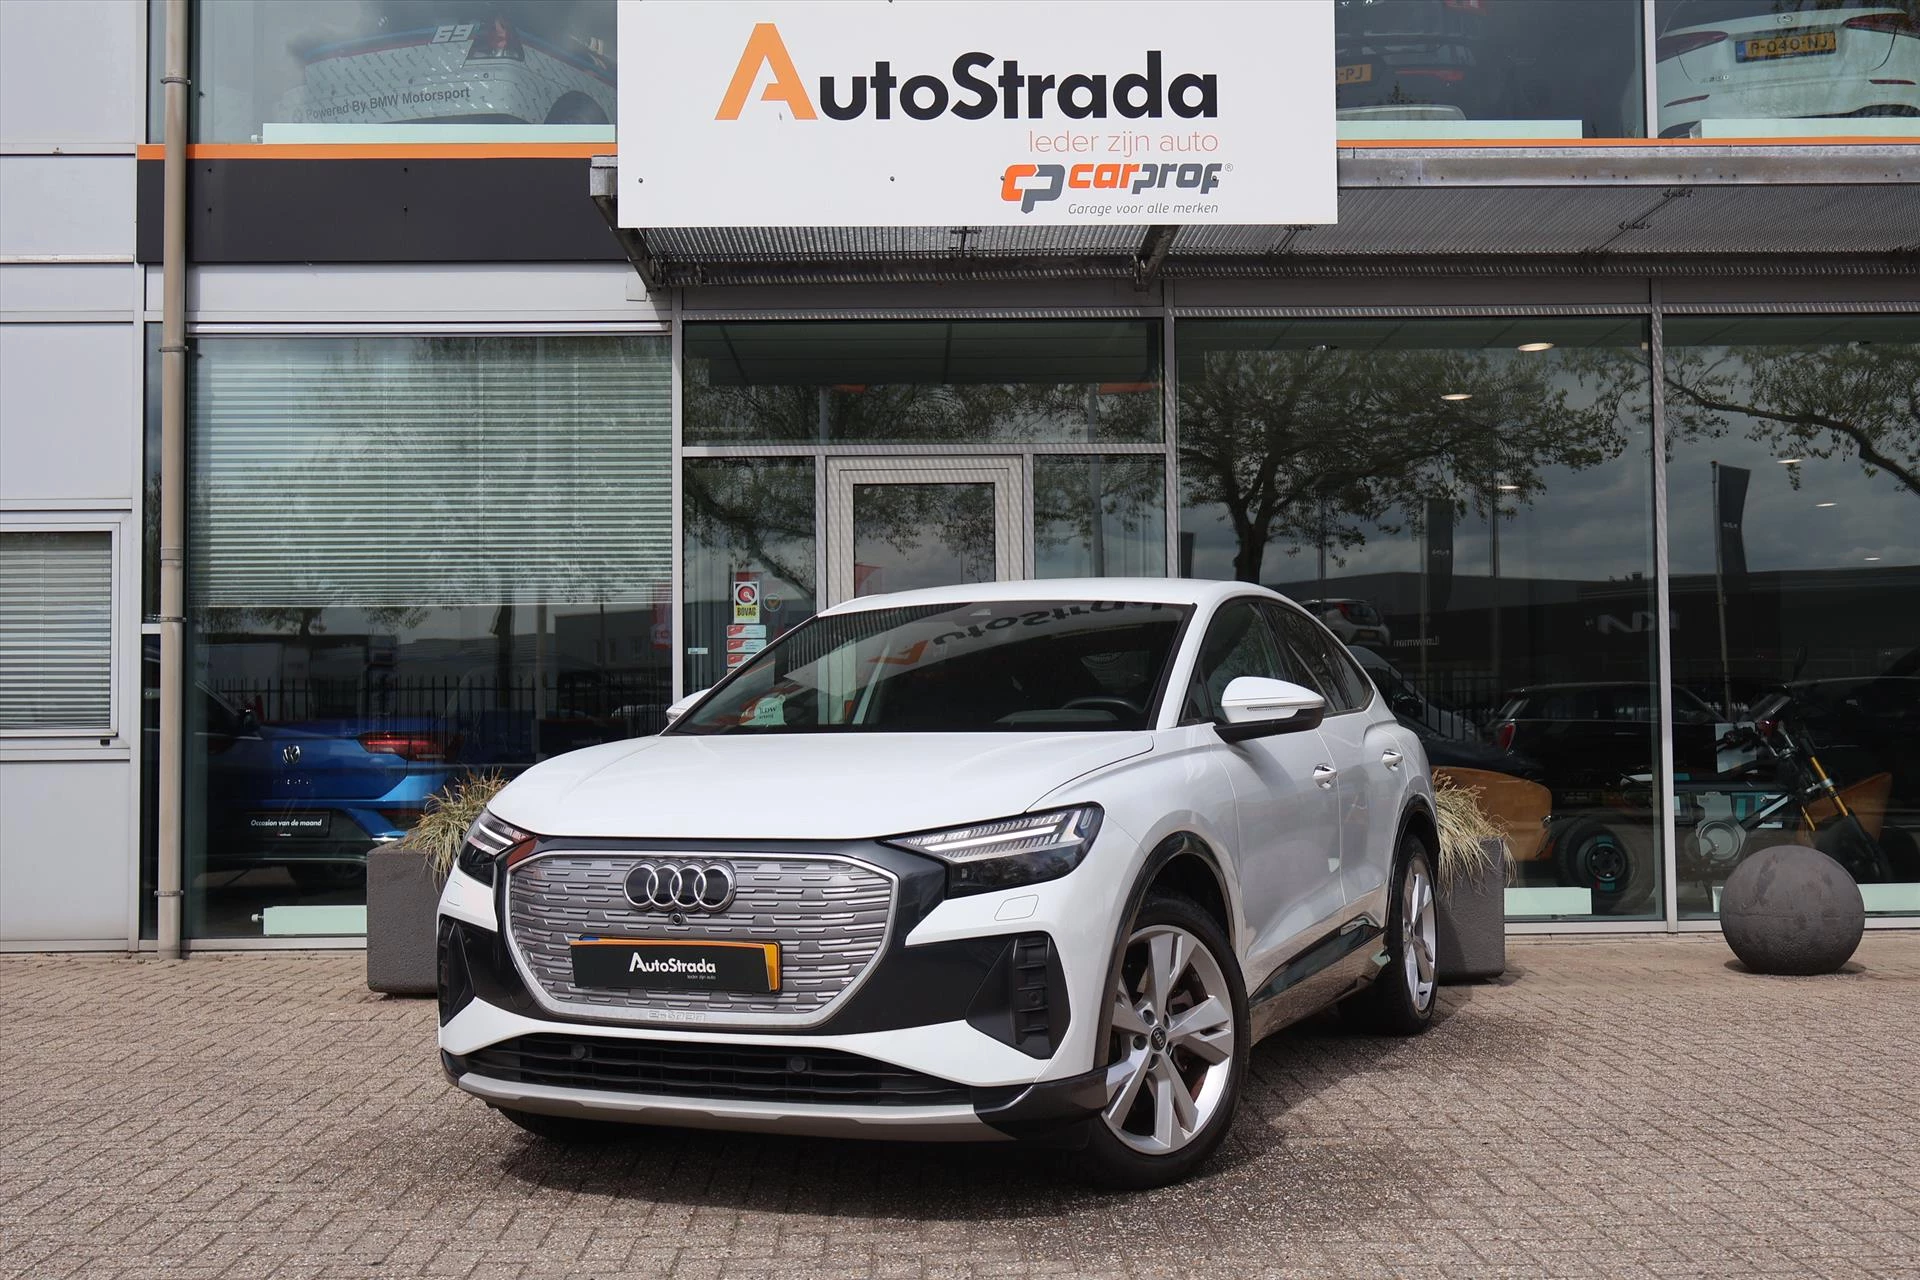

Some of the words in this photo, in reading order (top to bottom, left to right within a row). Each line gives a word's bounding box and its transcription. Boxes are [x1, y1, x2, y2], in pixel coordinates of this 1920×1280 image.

[432, 23, 474, 43] 69
[714, 22, 1218, 121] AutoStrada
[306, 101, 350, 120] Powered
[352, 98, 368, 114] By
[369, 93, 399, 109] BMW
[402, 86, 471, 105] Motorsport
[1029, 130, 1100, 152] Ieder
[1107, 130, 1150, 158] zijn
[1159, 132, 1219, 152] auto
[1068, 203, 1112, 217] Garage
[1116, 204, 1143, 215] voor
[1147, 202, 1169, 214] alle
[1173, 202, 1219, 214] merken
[736, 606, 757, 617] BOVAG
[250, 819, 278, 827] Occasion
[290, 819, 299, 827] de
[299, 818, 323, 827] maand
[629, 952, 717, 974] AutoStrada
